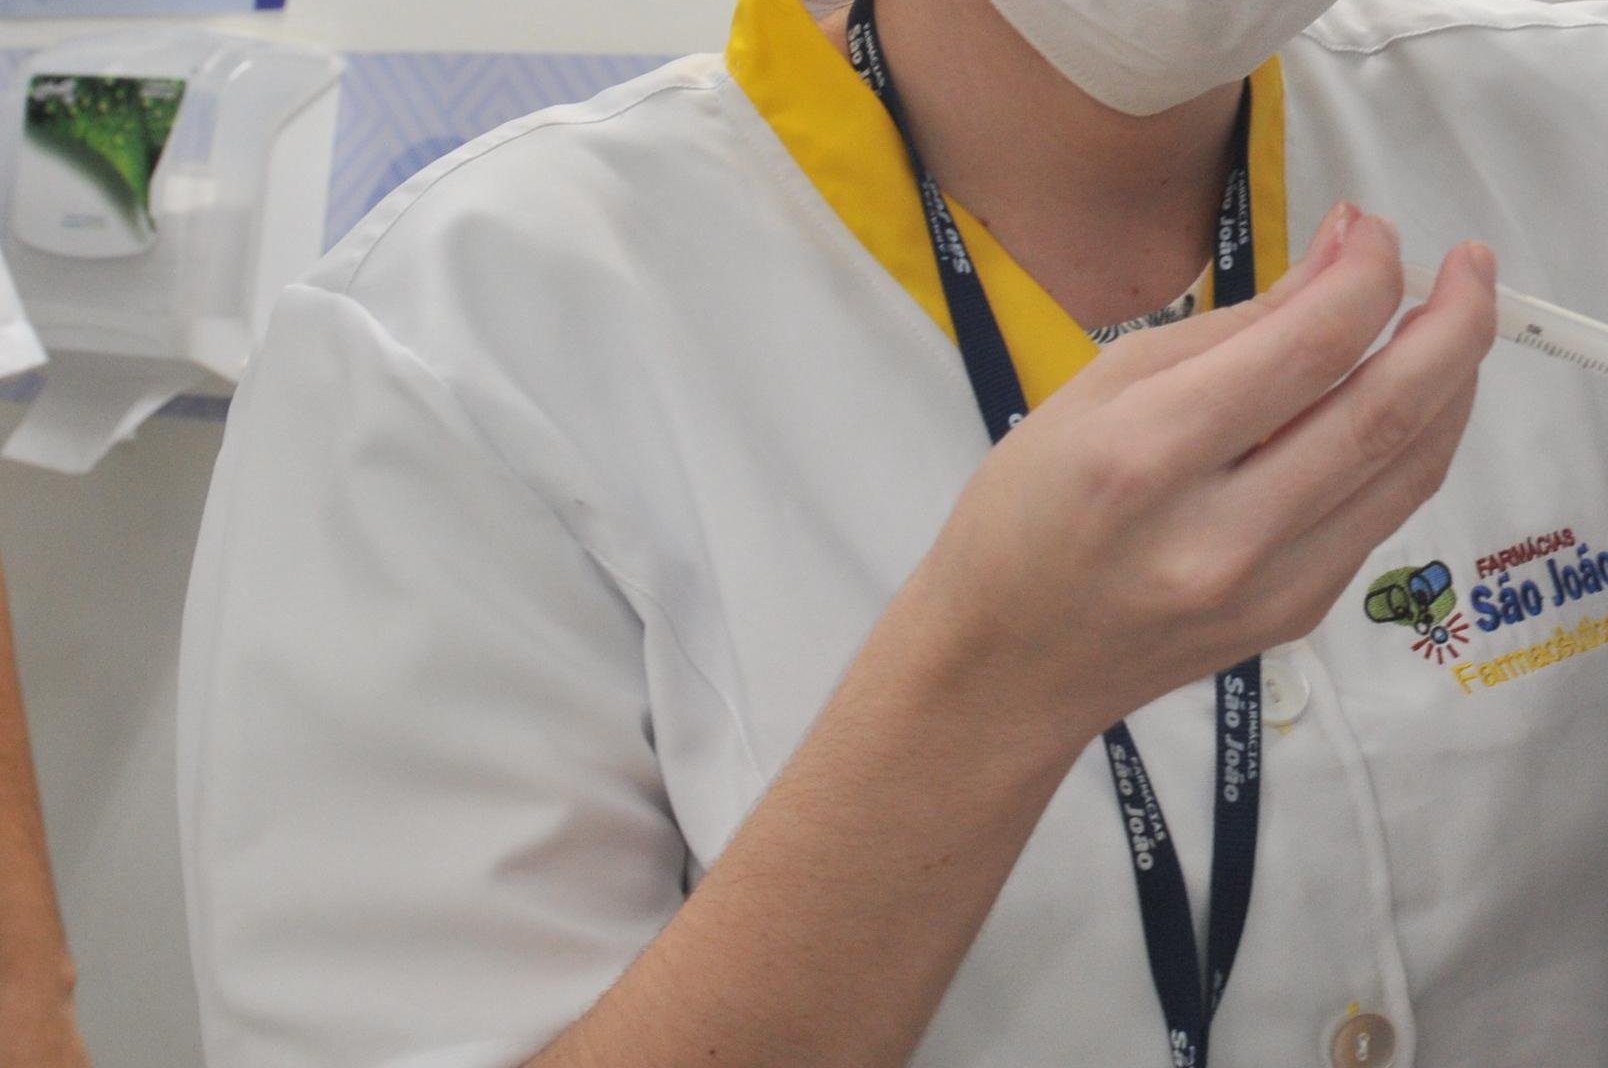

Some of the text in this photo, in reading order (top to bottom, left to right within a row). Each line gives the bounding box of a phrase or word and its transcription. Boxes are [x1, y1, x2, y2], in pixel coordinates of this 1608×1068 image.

[1218, 216, 1238, 271] João
[1475, 527, 1576, 580] FARMÁCIAS
[1470, 572, 1544, 633] São
[1223, 674, 1245, 803] São João
[1109, 743, 1157, 871] São João
